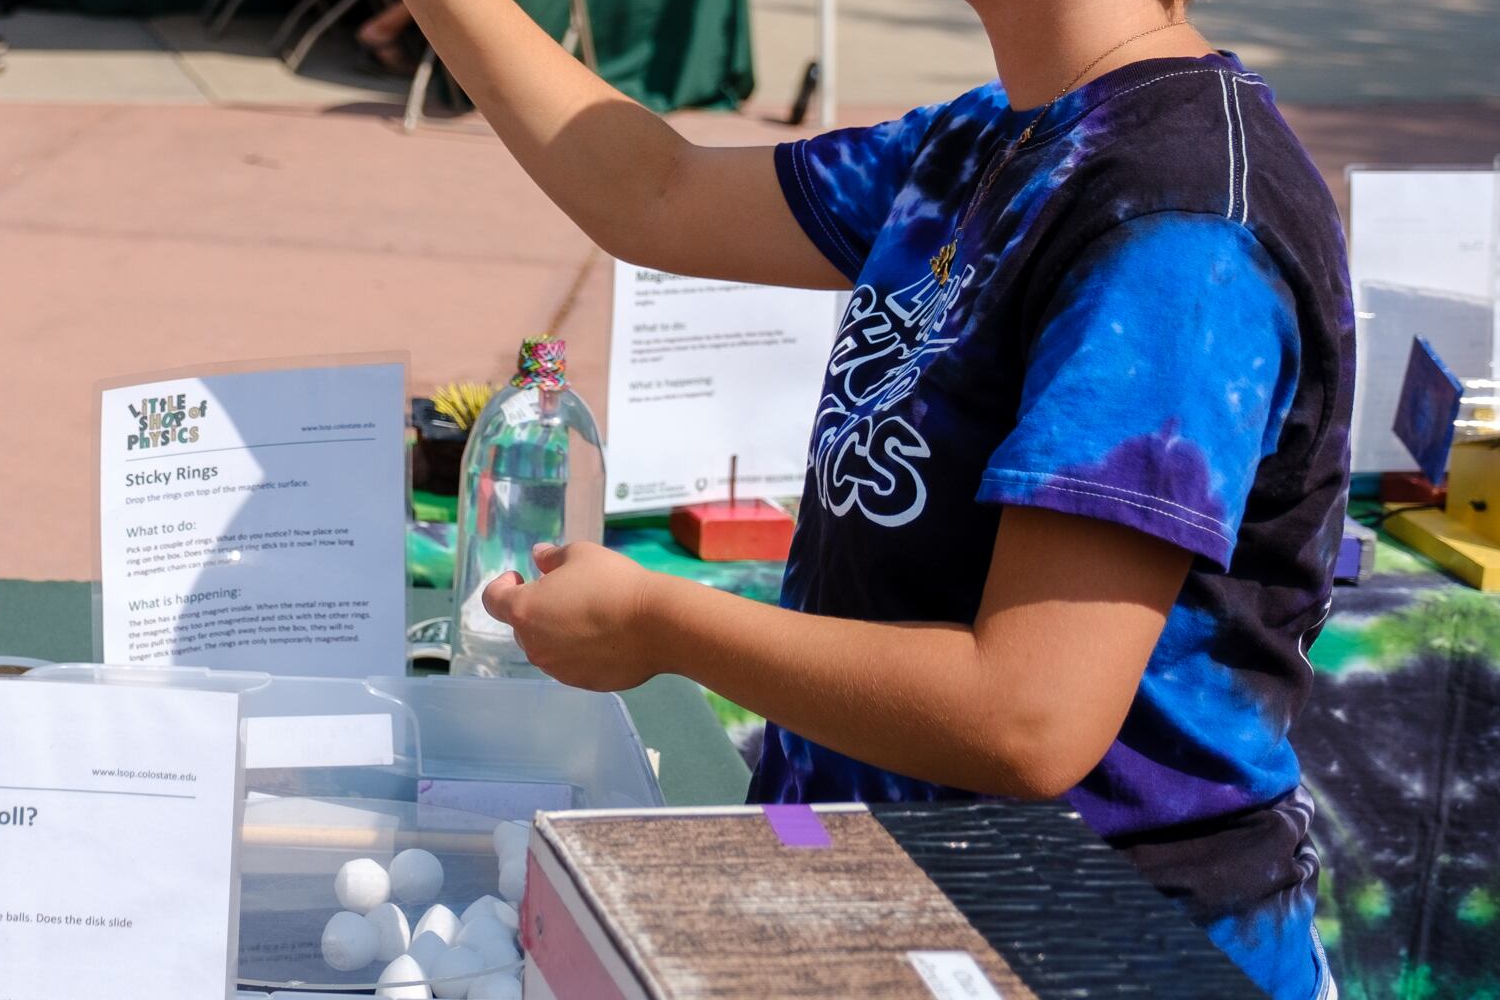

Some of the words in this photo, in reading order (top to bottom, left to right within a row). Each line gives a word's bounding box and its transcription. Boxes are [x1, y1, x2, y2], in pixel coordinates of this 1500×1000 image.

[139, 411, 186, 431] SHOP
[188, 400, 207, 419] of
[125, 470, 171, 487] Sticky
[177, 466, 218, 481] Rings
[125, 496, 145, 505] Drop
[148, 494, 160, 502] the
[163, 491, 182, 500] rings
[197, 488, 210, 496] top
[238, 481, 275, 491] magnetic
[278, 480, 310, 488] surface.
[126, 526, 158, 538] What
[162, 524, 174, 534] to
[178, 520, 196, 532] do:
[128, 598, 160, 611] What
[163, 596, 172, 606] is
[175, 587, 242, 604] happening:
[92, 768, 197, 782] www.lsop.colostate.edu
[6, 912, 33, 923] balls.
[36, 913, 62, 924] Does
[65, 915, 82, 925] the
[85, 916, 106, 927] disk
[109, 917, 133, 928] slide
